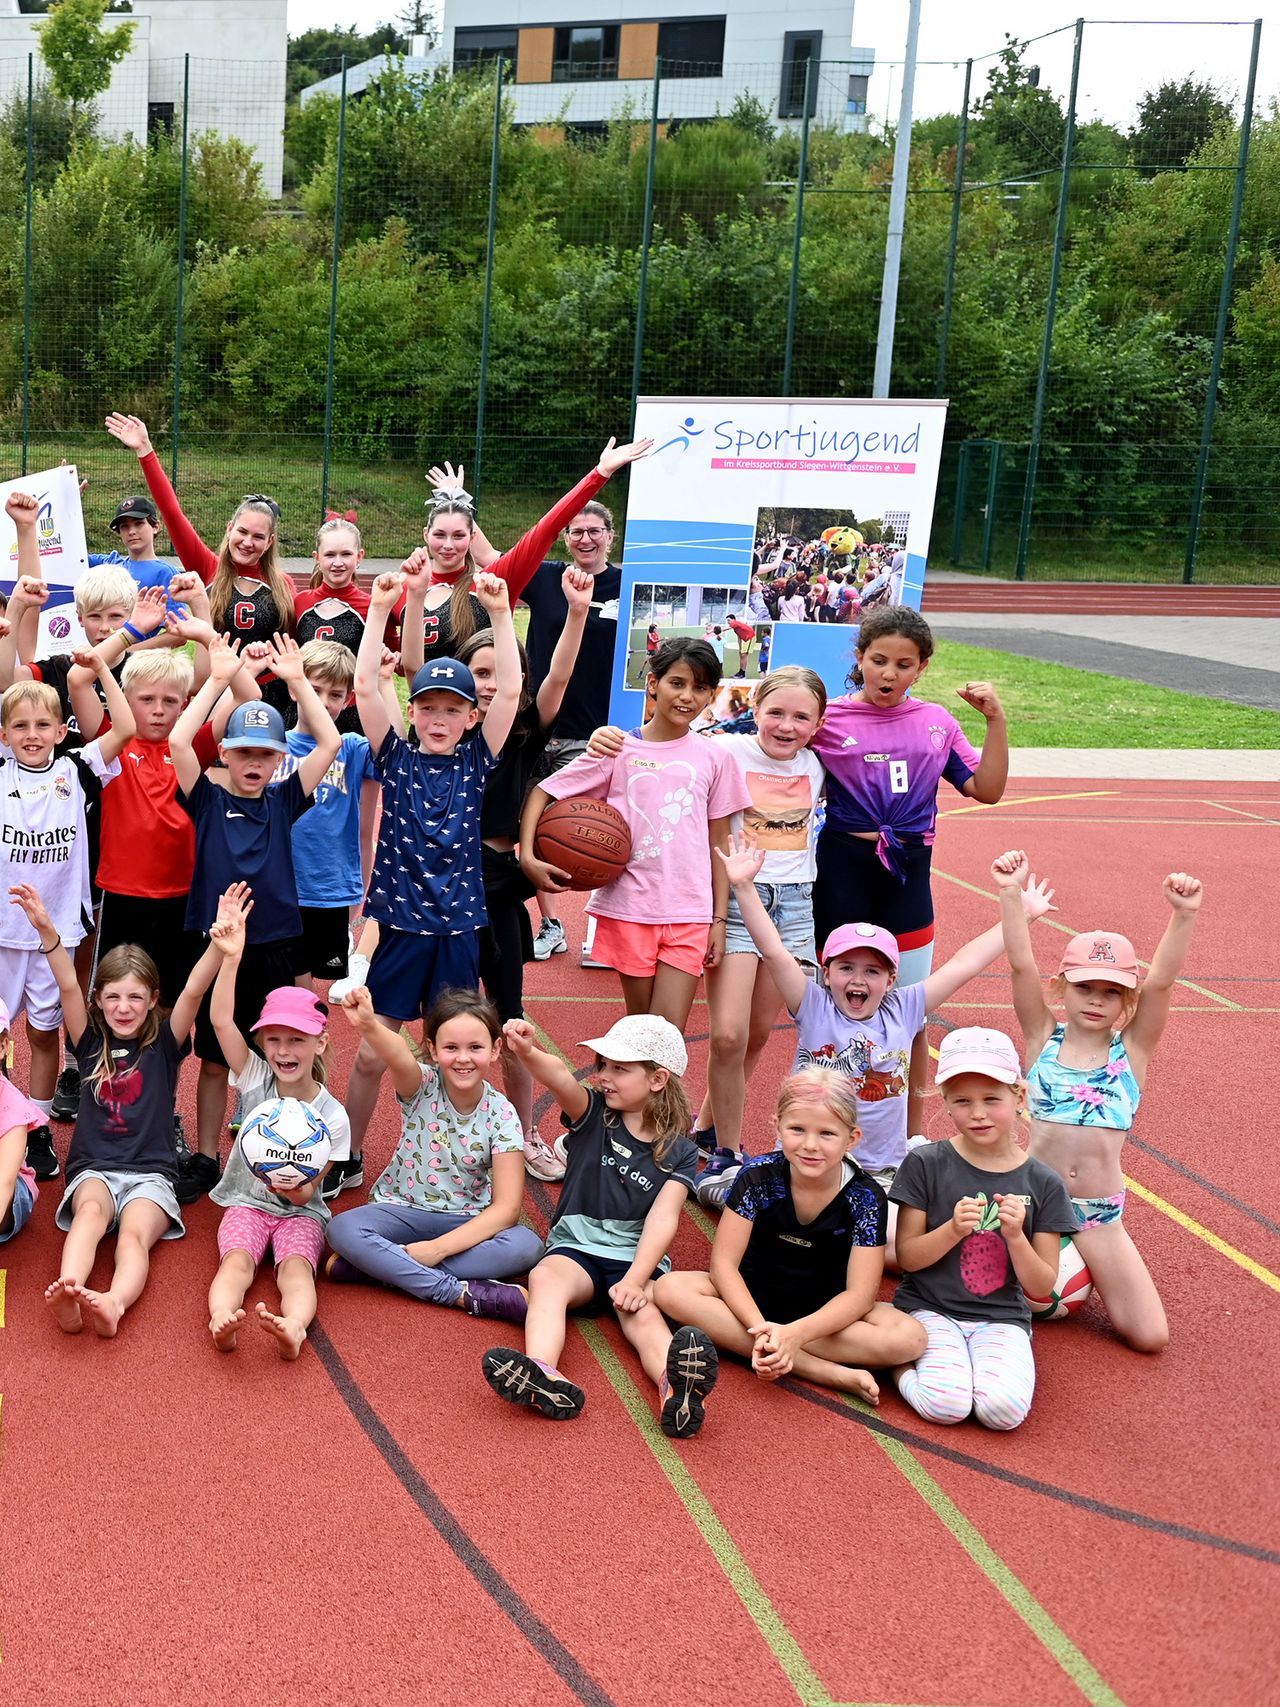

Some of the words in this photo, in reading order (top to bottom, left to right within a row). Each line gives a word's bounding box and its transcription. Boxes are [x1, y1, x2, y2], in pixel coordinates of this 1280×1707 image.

[713, 420, 921, 464] Sportjugend
[723, 460, 734, 468] im
[736, 460, 798, 470] Kreissportbund
[800, 462, 882, 472] Siegen-Wittgenstein
[233, 601, 256, 630] C
[423, 615, 440, 645] C
[245, 710, 269, 725] ES
[889, 760, 909, 794] 8
[2, 824, 77, 847] Emirates
[9, 848, 28, 863] FLY
[31, 846, 69, 863] BETTER
[266, 1148, 312, 1162] molten
[630, 1171, 654, 1192] day
